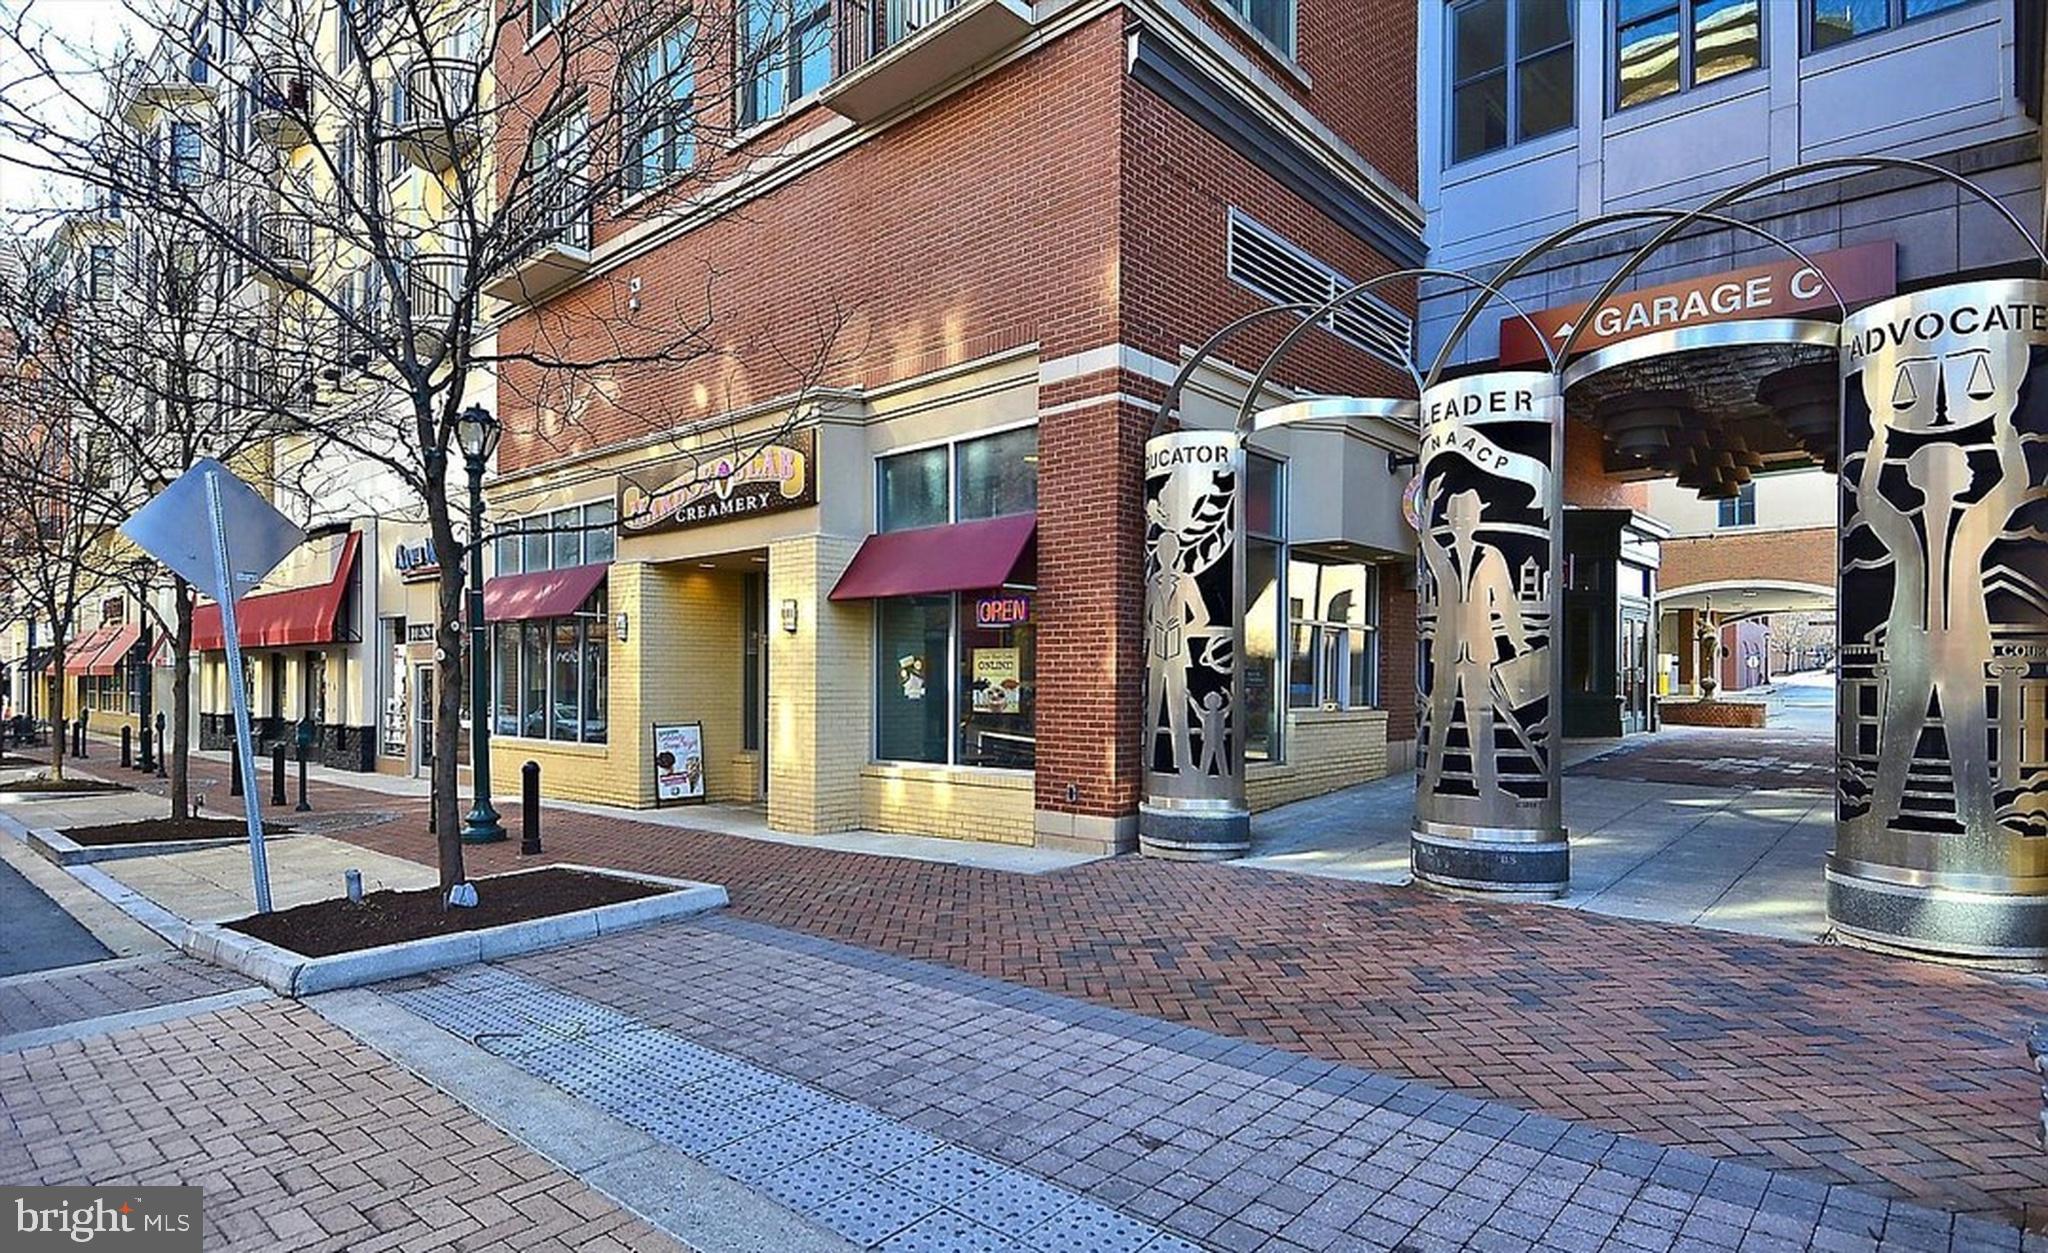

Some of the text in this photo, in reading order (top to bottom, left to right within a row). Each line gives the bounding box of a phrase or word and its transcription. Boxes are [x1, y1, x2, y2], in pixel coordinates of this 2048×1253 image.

[1594, 267, 1822, 337] GARAGE C
[1851, 304, 2047, 361] ADVOCATE
[1423, 390, 1532, 427] LEADER
[1146, 446, 1229, 473] UCATOR
[1431, 432, 1509, 469] NAACP
[675, 493, 771, 522] CREAMERY
[981, 600, 1025, 622] OPEN
